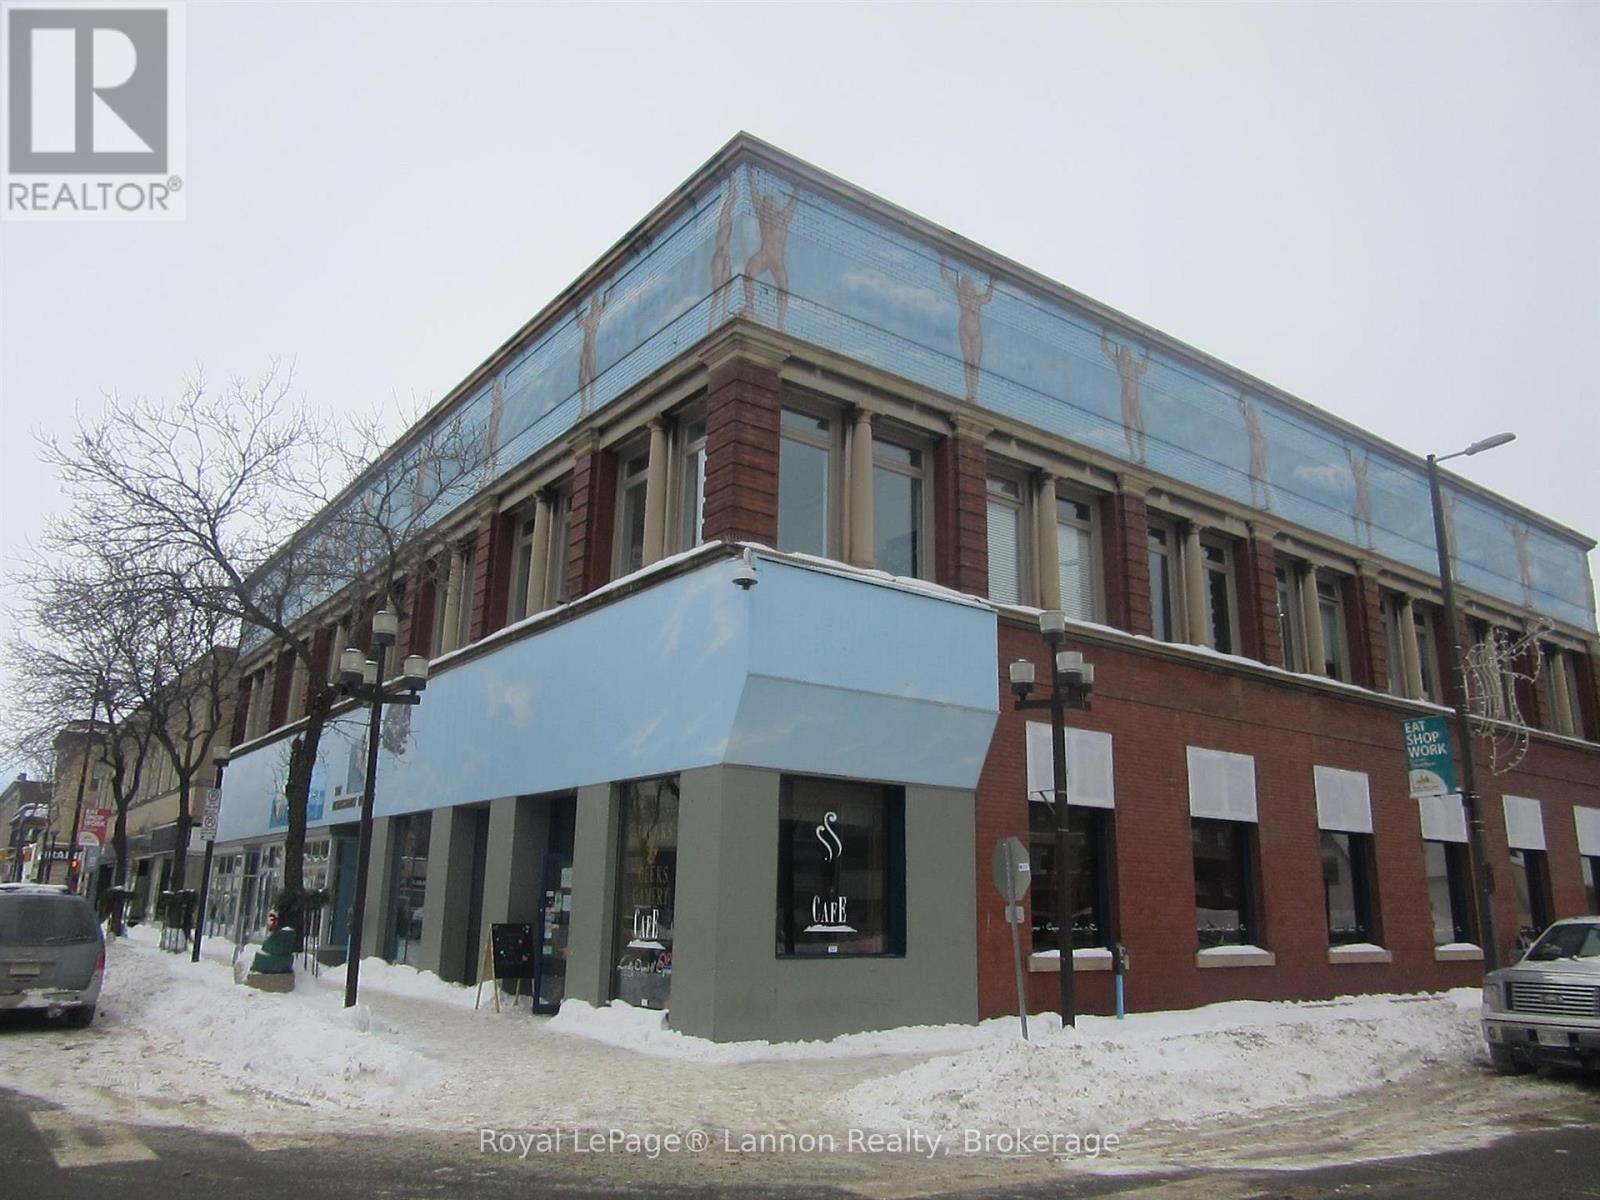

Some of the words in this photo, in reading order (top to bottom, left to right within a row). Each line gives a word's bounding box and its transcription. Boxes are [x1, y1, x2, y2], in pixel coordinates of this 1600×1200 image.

[1404, 720, 1425, 734] EAT
[1406, 731, 1440, 746] SHOP
[1408, 743, 1447, 758] WORK
